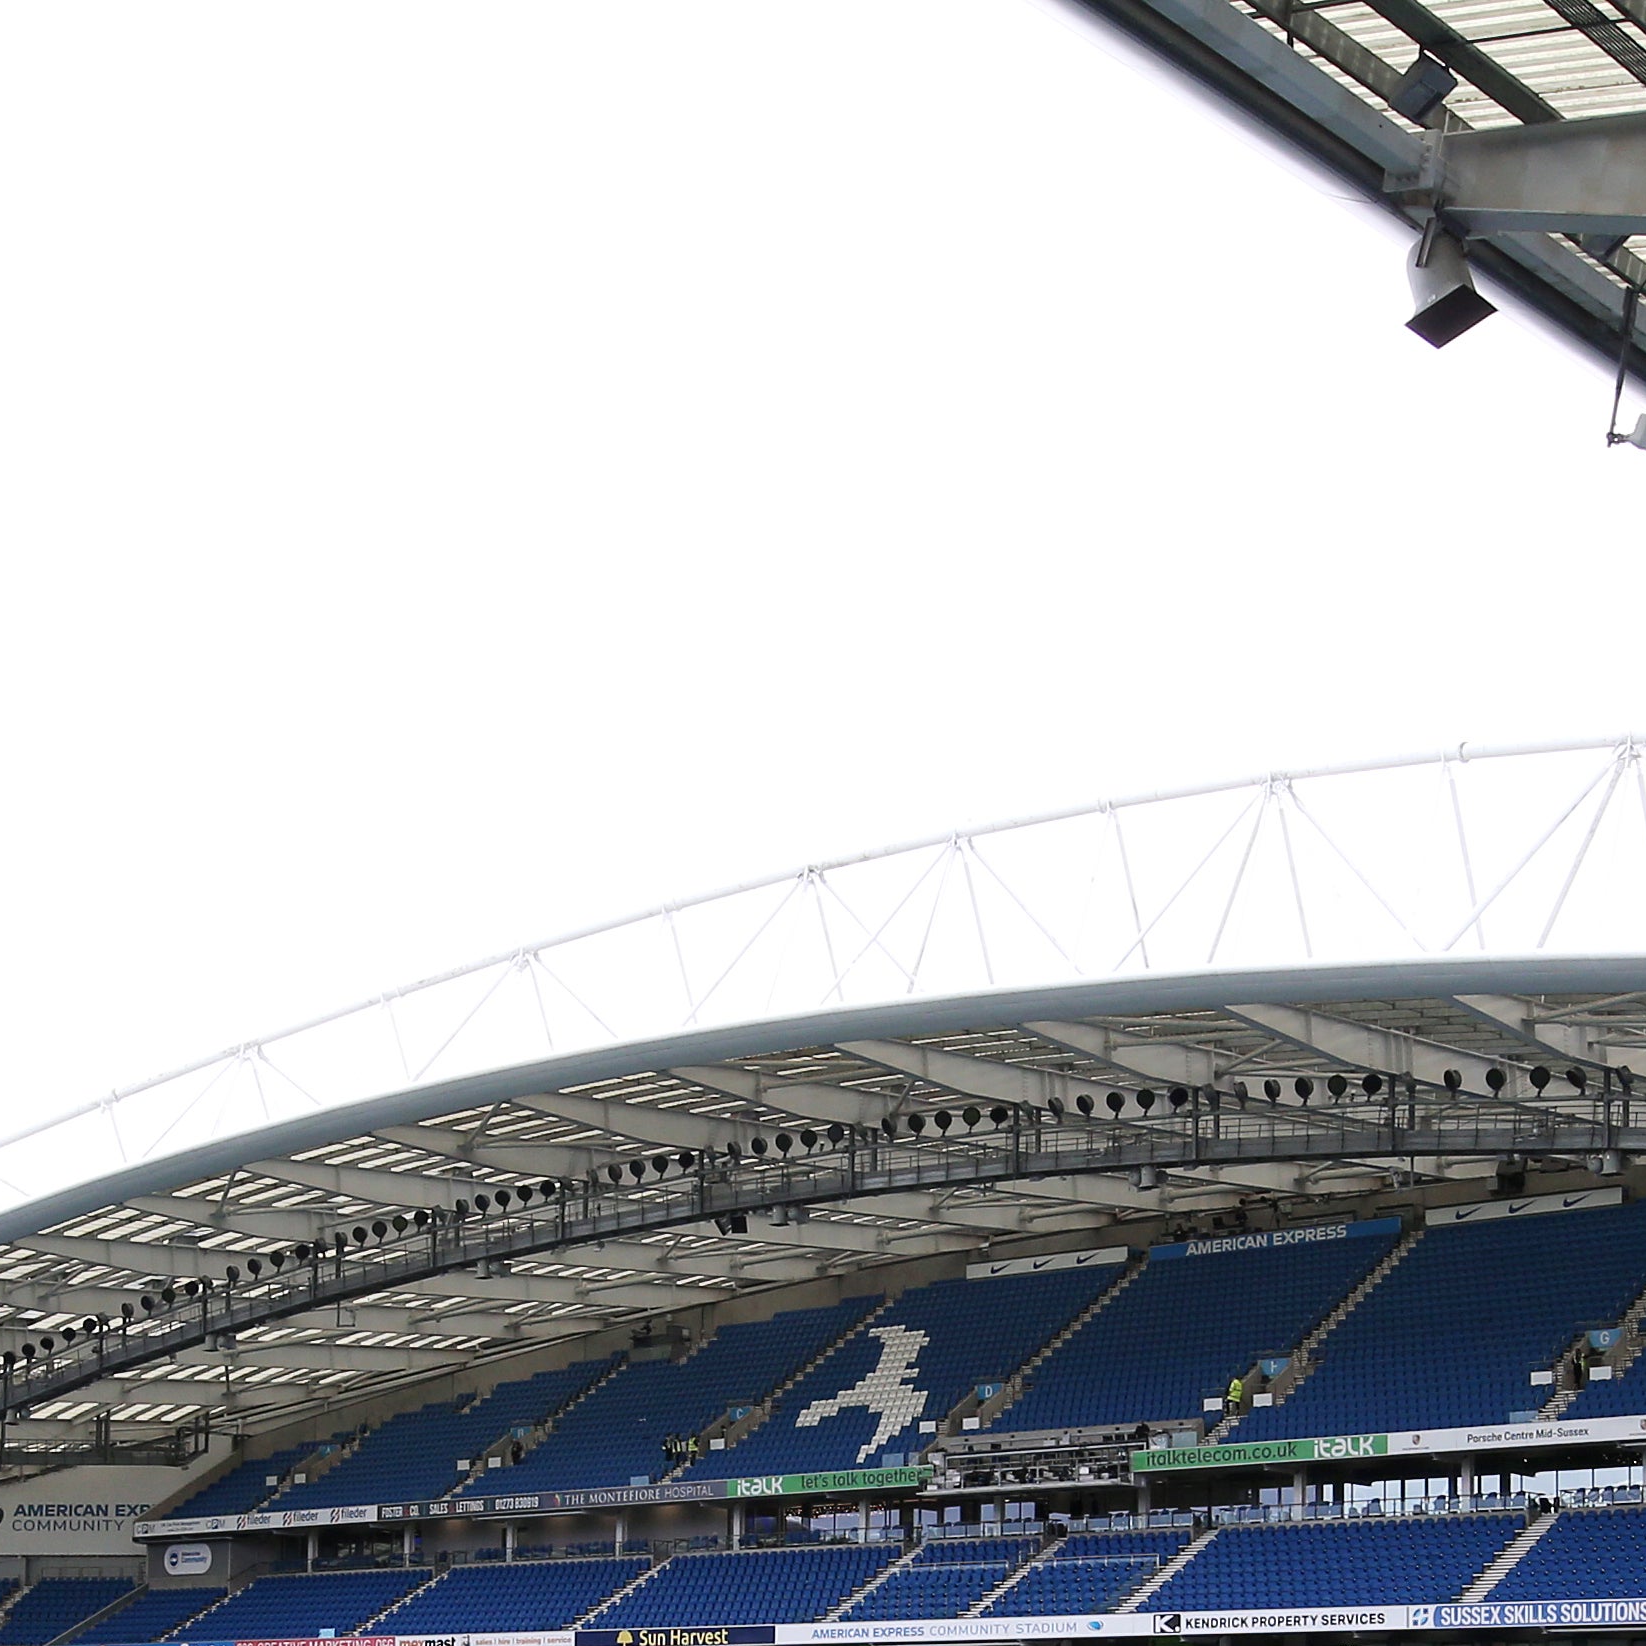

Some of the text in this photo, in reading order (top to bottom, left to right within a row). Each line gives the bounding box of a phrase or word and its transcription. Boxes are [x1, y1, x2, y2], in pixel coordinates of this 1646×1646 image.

[1186, 1225, 1347, 1256] AMERICAN EXPRESS
[1599, 1332, 1609, 1345] G
[983, 1385, 993, 1397] D
[1467, 1427, 1590, 1444] Porsche Centre Mid-Sussex
[1147, 1441, 1298, 1467] italktelecom.co.uk
[801, 1473, 829, 1488] let's
[834, 1471, 858, 1487] talk
[863, 1469, 922, 1490] together
[565, 1484, 714, 1505] THE MONTEFIORE HOSPITAL
[14, 1503, 110, 1517] AMERICAN
[381, 1506, 403, 1518] FOSTER
[429, 1502, 449, 1515] SALES
[12, 1519, 125, 1532] COMMUNITY
[1185, 1612, 1385, 1629] KENDRICK PROPERTY SERVICES
[1440, 1606, 1501, 1626] SUSSEX
[1504, 1604, 1557, 1624] SKILLS
[639, 1628, 729, 1646] Sun Harvest
[811, 1621, 1077, 1640] AMERICAN EXPRESS COMMUNITY STADIUM
[475, 1637, 492, 1646] sales
[497, 1636, 511, 1645] hire
[516, 1636, 542, 1646] training
[547, 1635, 572, 1645] service
